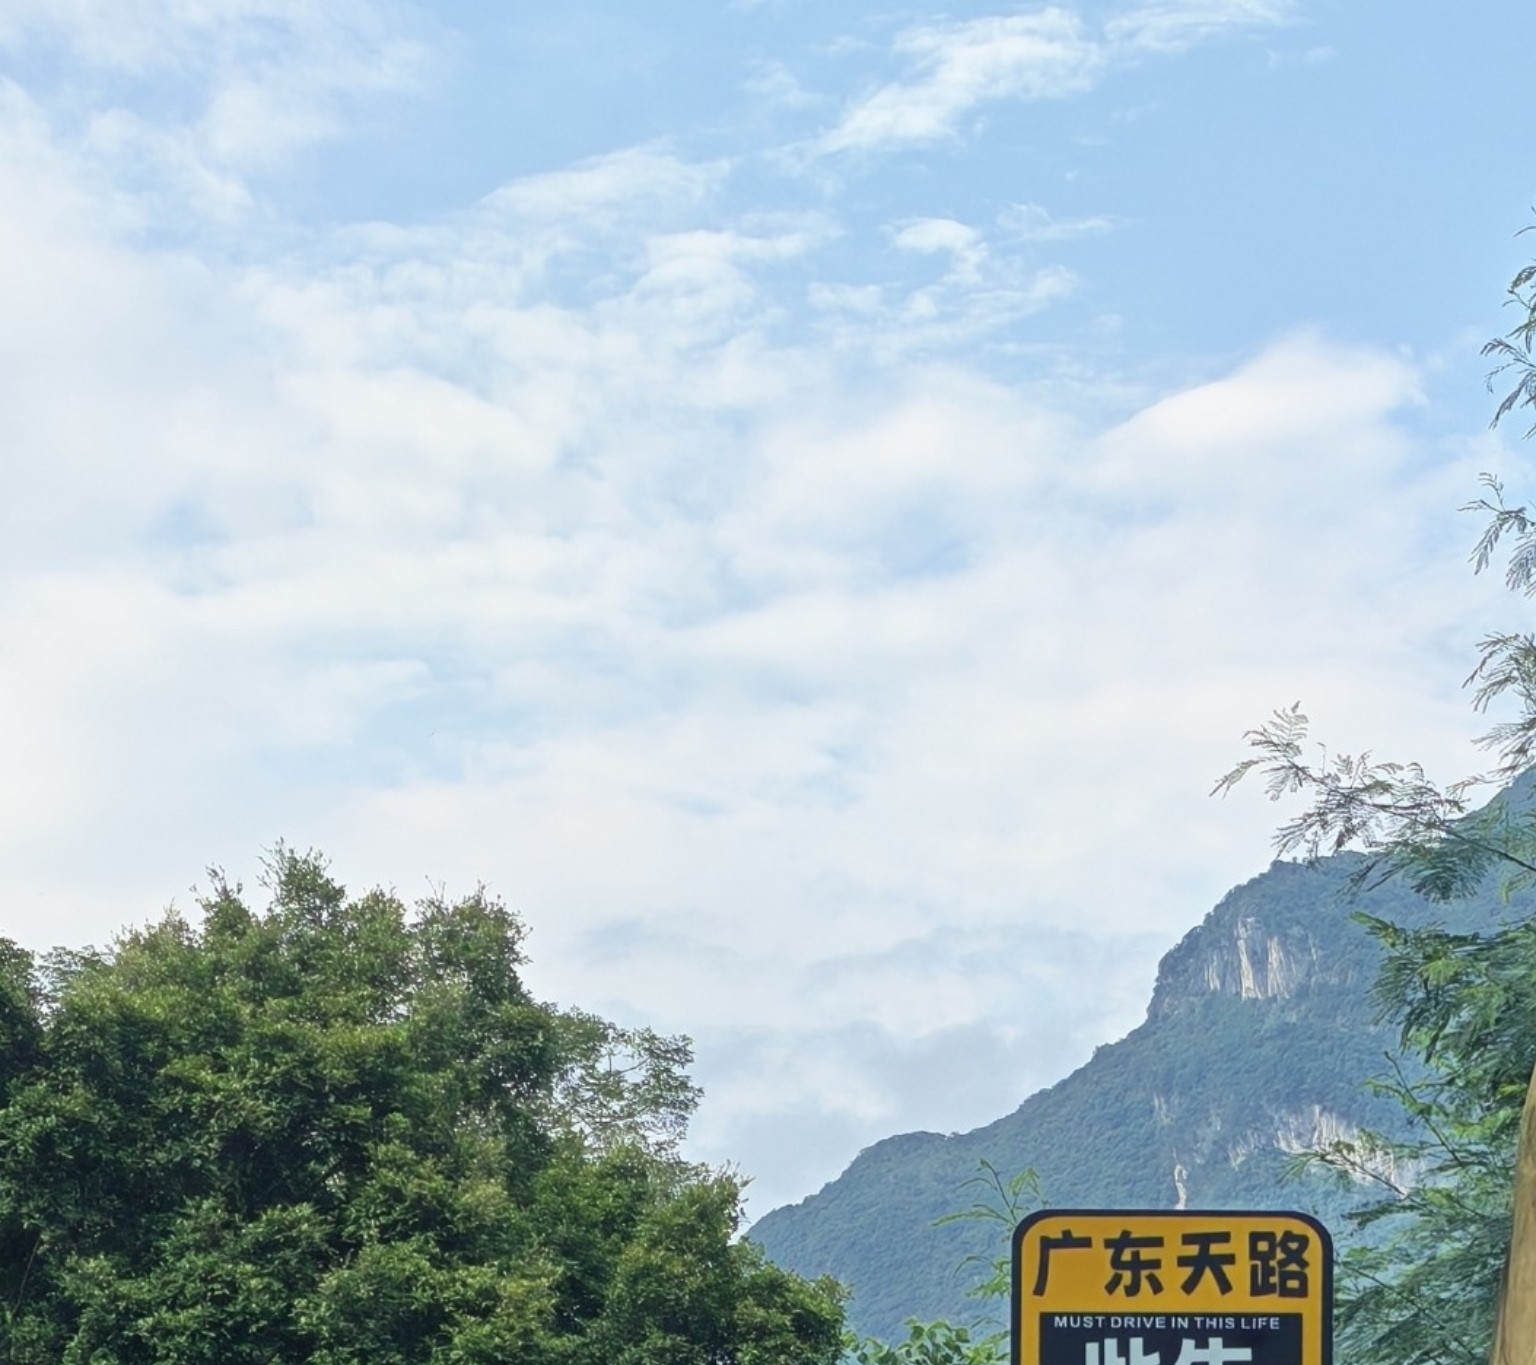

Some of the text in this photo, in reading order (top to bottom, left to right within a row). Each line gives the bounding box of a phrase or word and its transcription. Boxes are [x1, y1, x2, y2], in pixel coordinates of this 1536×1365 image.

[1032, 1229, 1311, 1299] 广东天路
[1053, 1315, 1281, 1330] MUST DRIVE IN THIS LIFE
